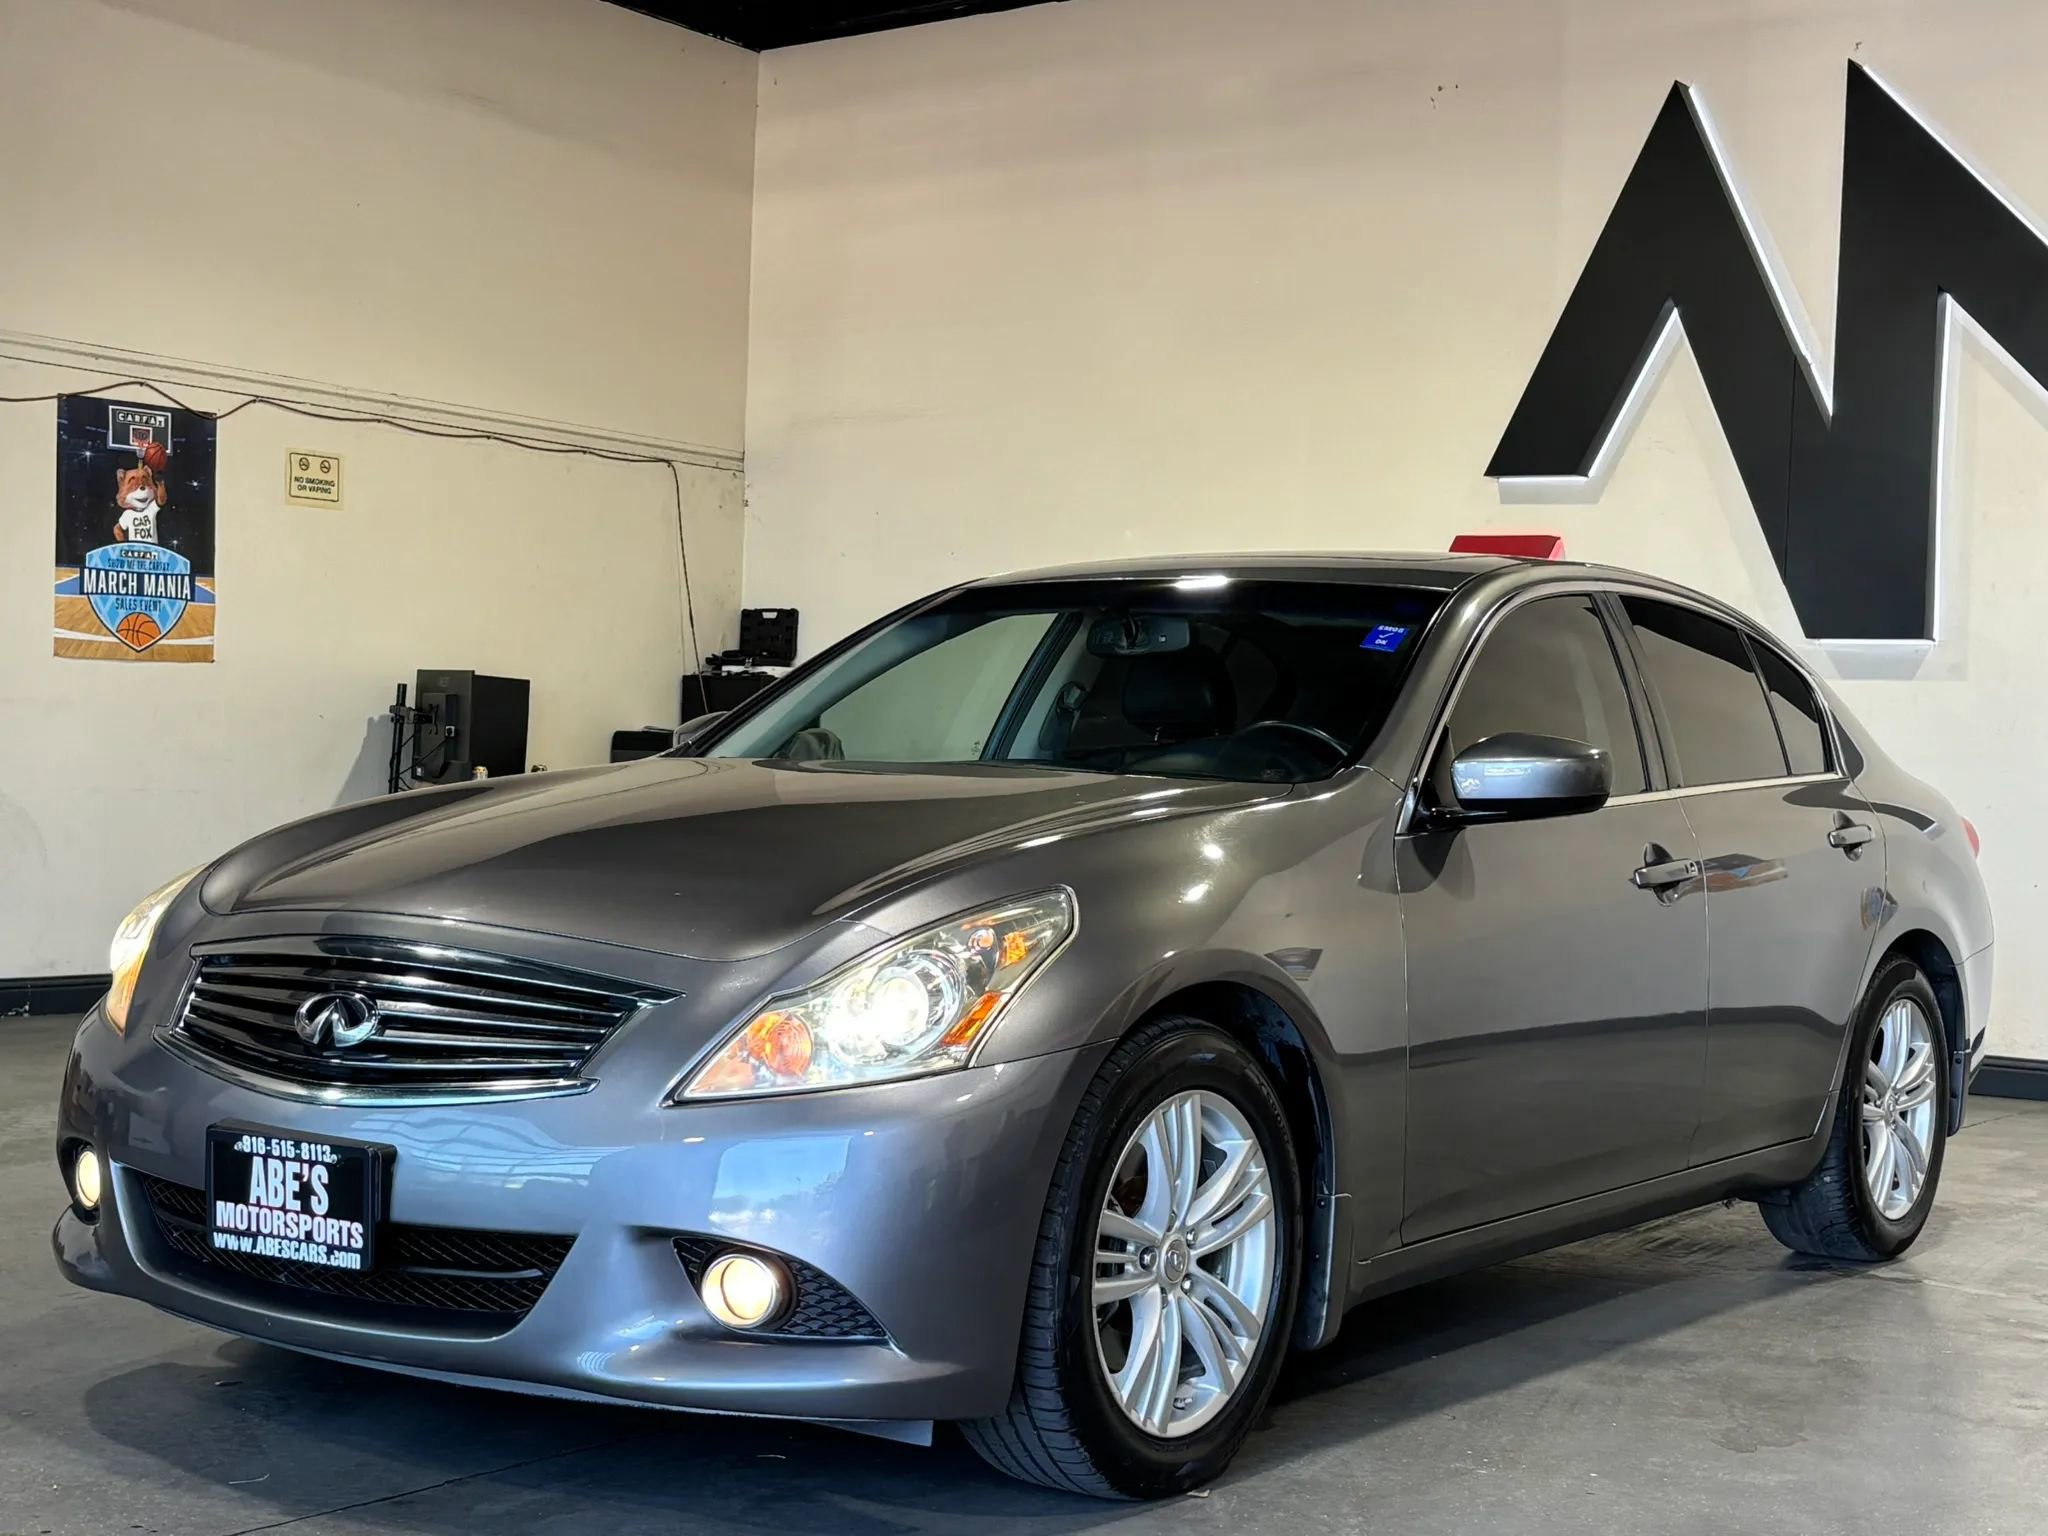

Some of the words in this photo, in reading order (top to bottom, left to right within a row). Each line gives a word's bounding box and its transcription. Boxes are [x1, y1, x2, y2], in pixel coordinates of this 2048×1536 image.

[117, 412, 165, 427] CARFAX
[294, 476, 304, 484] NO
[304, 477, 335, 487] SMOKING
[308, 485, 332, 494] VAPING
[132, 515, 151, 527] CAR
[134, 527, 152, 539] FOX
[84, 568, 137, 595] MARCH
[143, 573, 191, 600] MANIA
[115, 597, 137, 611] SALES
[140, 599, 162, 612] EVENT
[241, 1135, 332, 1164] 916-515-8113
[249, 1155, 330, 1216] ABE'S
[215, 1200, 364, 1249] MOTORSPORTS
